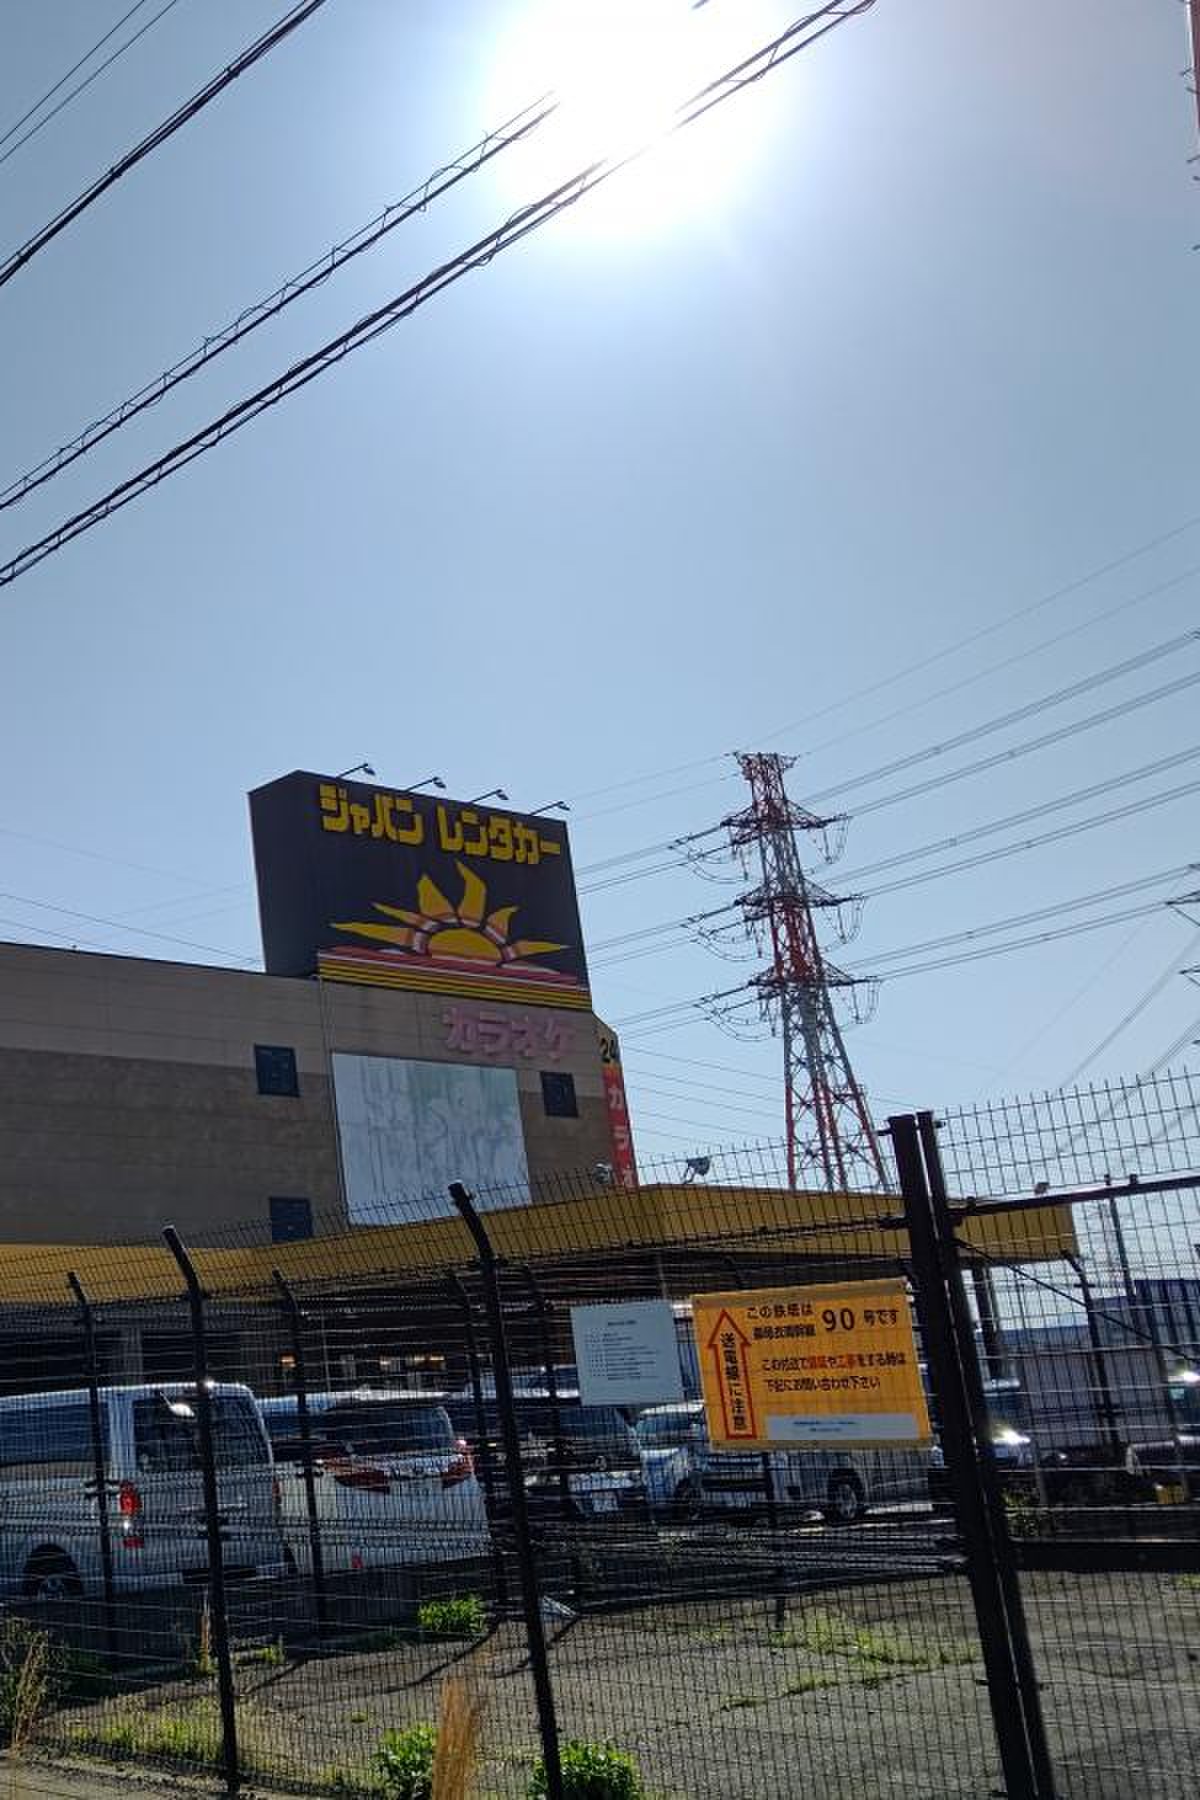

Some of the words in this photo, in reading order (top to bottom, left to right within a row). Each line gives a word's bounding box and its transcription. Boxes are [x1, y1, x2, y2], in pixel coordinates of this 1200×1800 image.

[319, 784, 424, 846] ジャパン
[437, 803, 561, 865] レンタカー
[442, 1006, 575, 1062] カラオケ
[822, 1307, 855, 1331] 90
